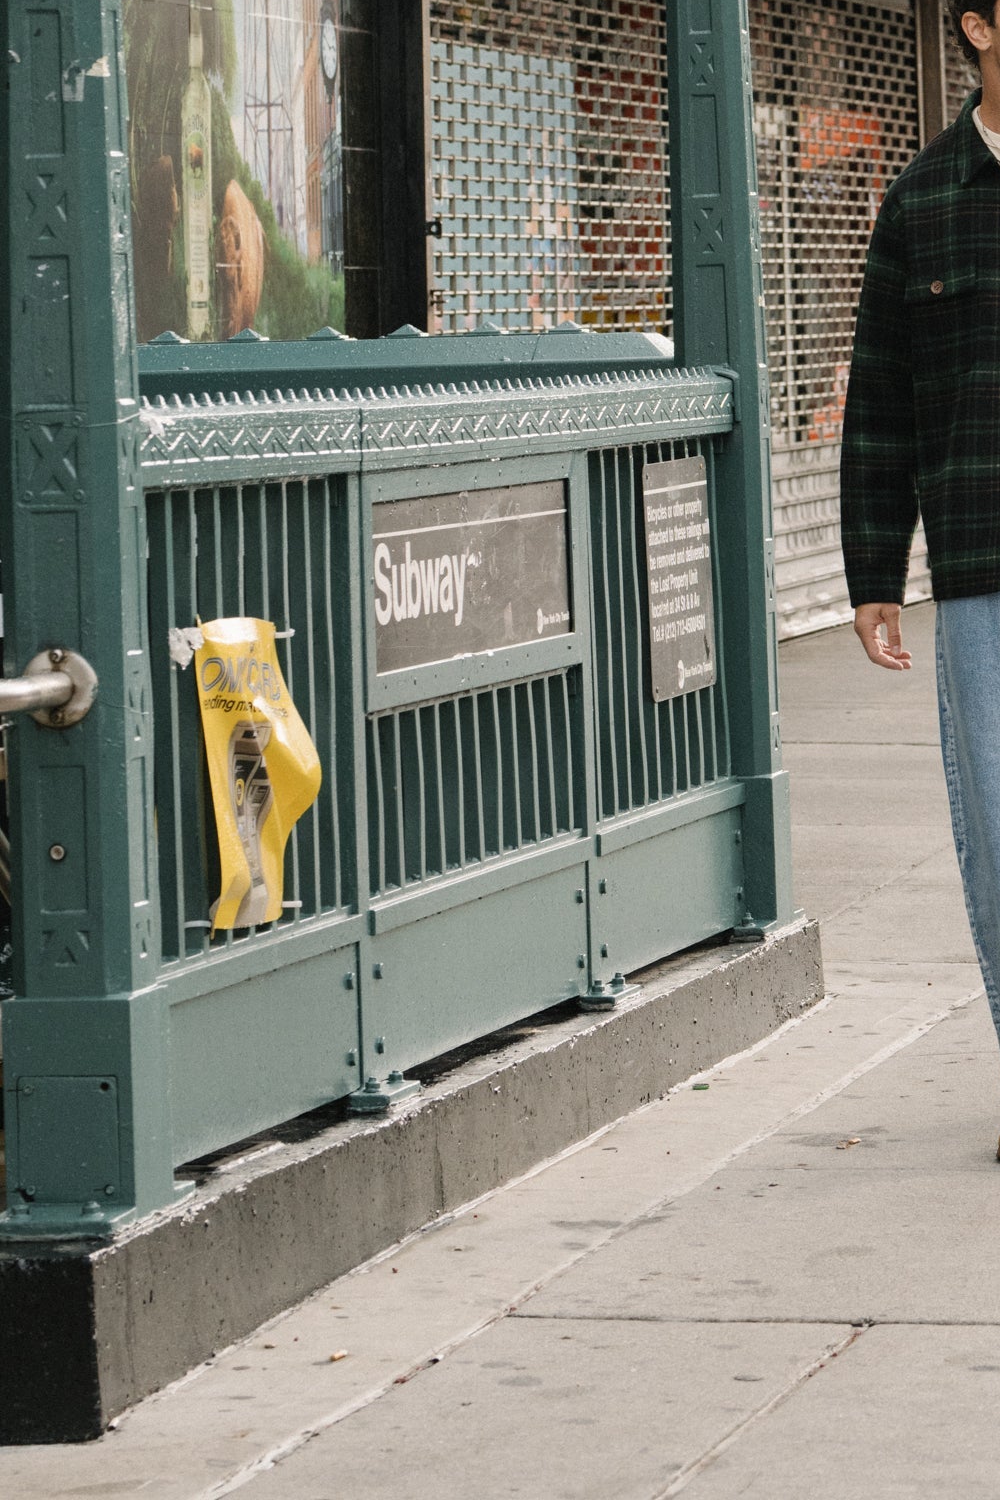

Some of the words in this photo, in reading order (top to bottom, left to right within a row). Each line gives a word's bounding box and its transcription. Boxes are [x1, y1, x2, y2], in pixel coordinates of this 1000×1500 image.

[647, 504, 667, 524] Bicycles
[648, 527, 668, 546] attached
[649, 555, 656, 571] be
[657, 549, 676, 569] removed
[374, 541, 466, 626] Subway
